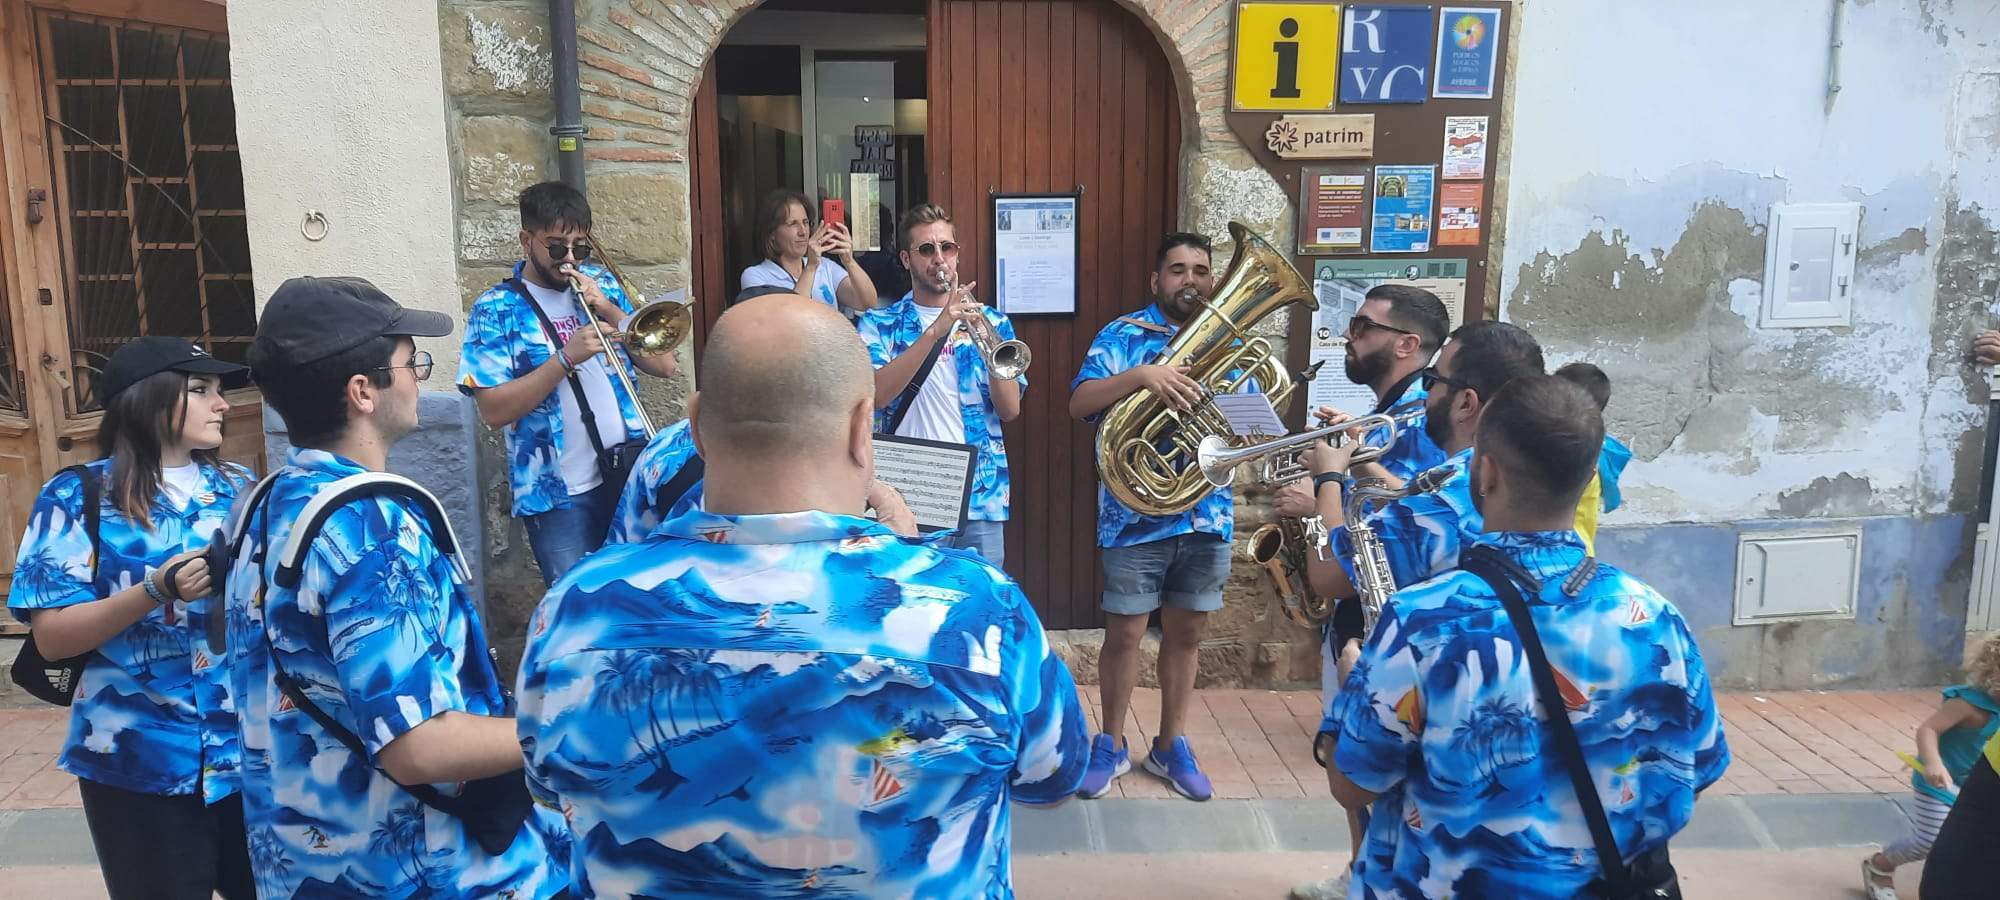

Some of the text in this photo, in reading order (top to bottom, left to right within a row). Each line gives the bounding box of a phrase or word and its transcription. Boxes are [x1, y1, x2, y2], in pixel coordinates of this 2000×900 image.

[1303, 127, 1363, 149] patrim
[1318, 328, 1330, 338] 10
[59, 667, 72, 693] adidas
